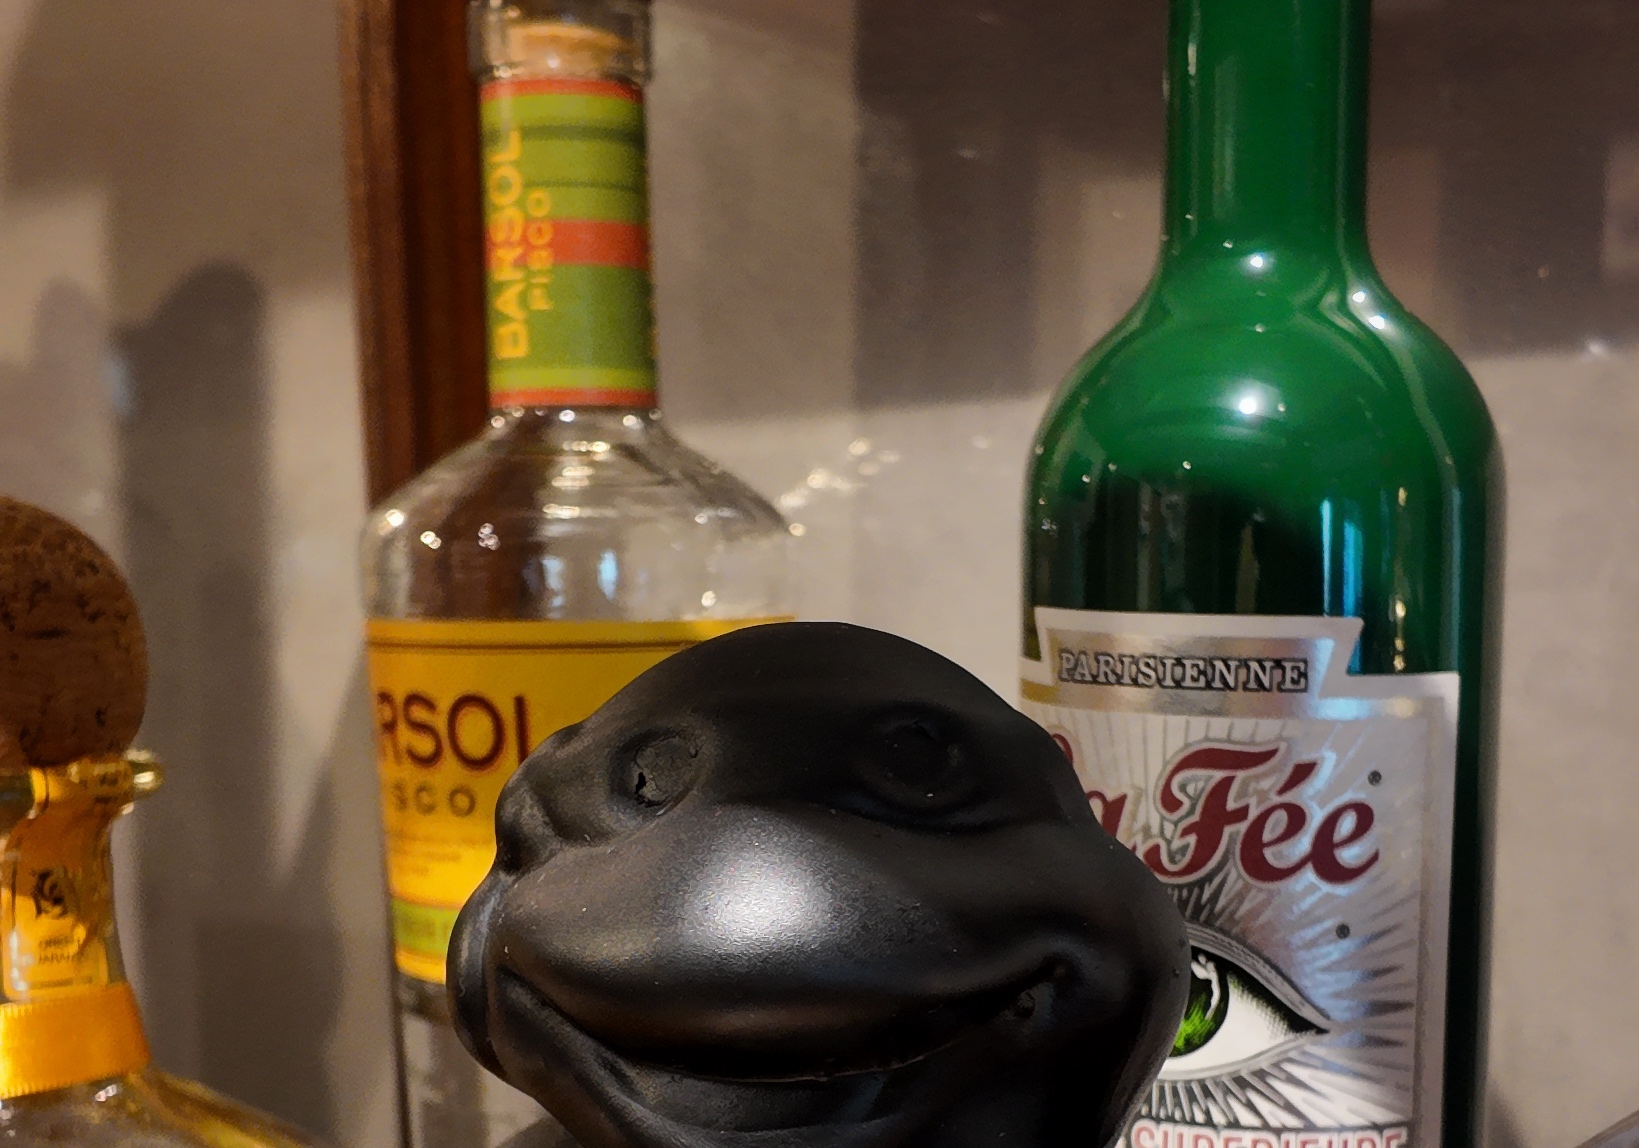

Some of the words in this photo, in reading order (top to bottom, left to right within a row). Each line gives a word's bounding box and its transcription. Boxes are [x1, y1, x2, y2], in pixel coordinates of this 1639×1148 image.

[489, 127, 529, 360] BARSOL
[526, 189, 554, 312] PISCO
[1057, 649, 1309, 693] PARISIENNE
[1142, 746, 1380, 884] Fée
